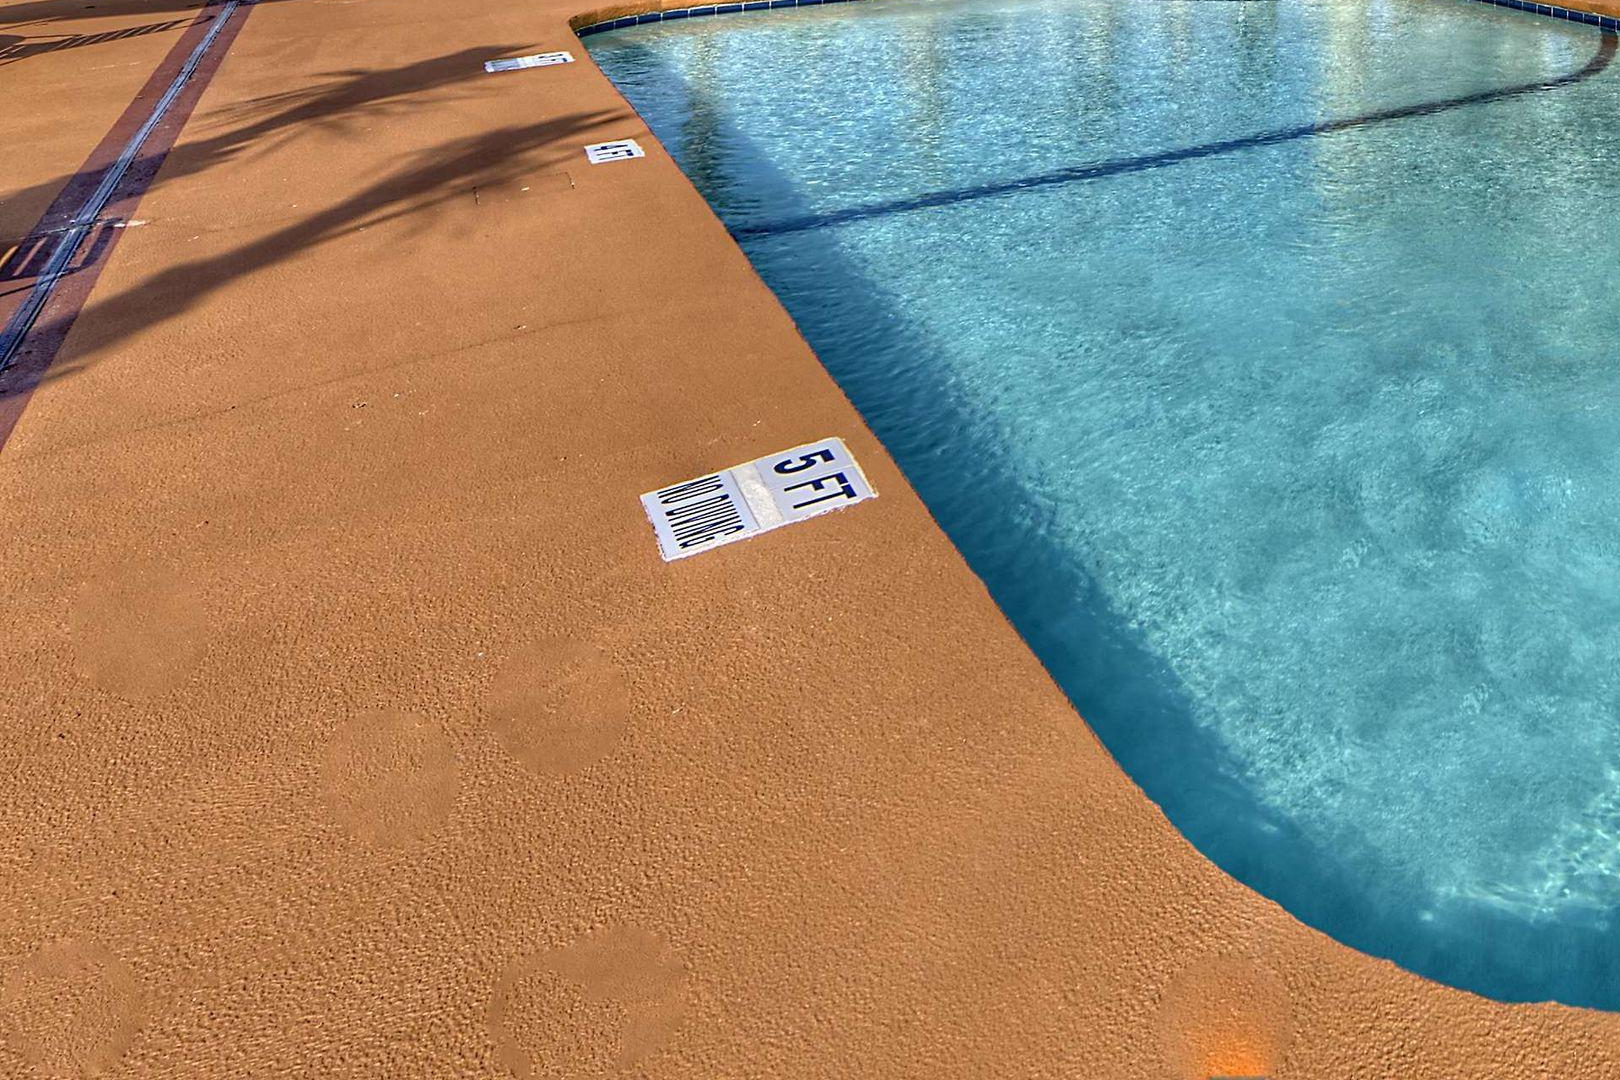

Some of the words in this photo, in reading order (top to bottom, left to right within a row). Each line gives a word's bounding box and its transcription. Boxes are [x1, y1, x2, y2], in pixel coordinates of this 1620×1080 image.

[773, 448, 836, 475] 5
[656, 474, 724, 505] NO
[784, 471, 858, 510] FT
[665, 493, 745, 550] DIVING
